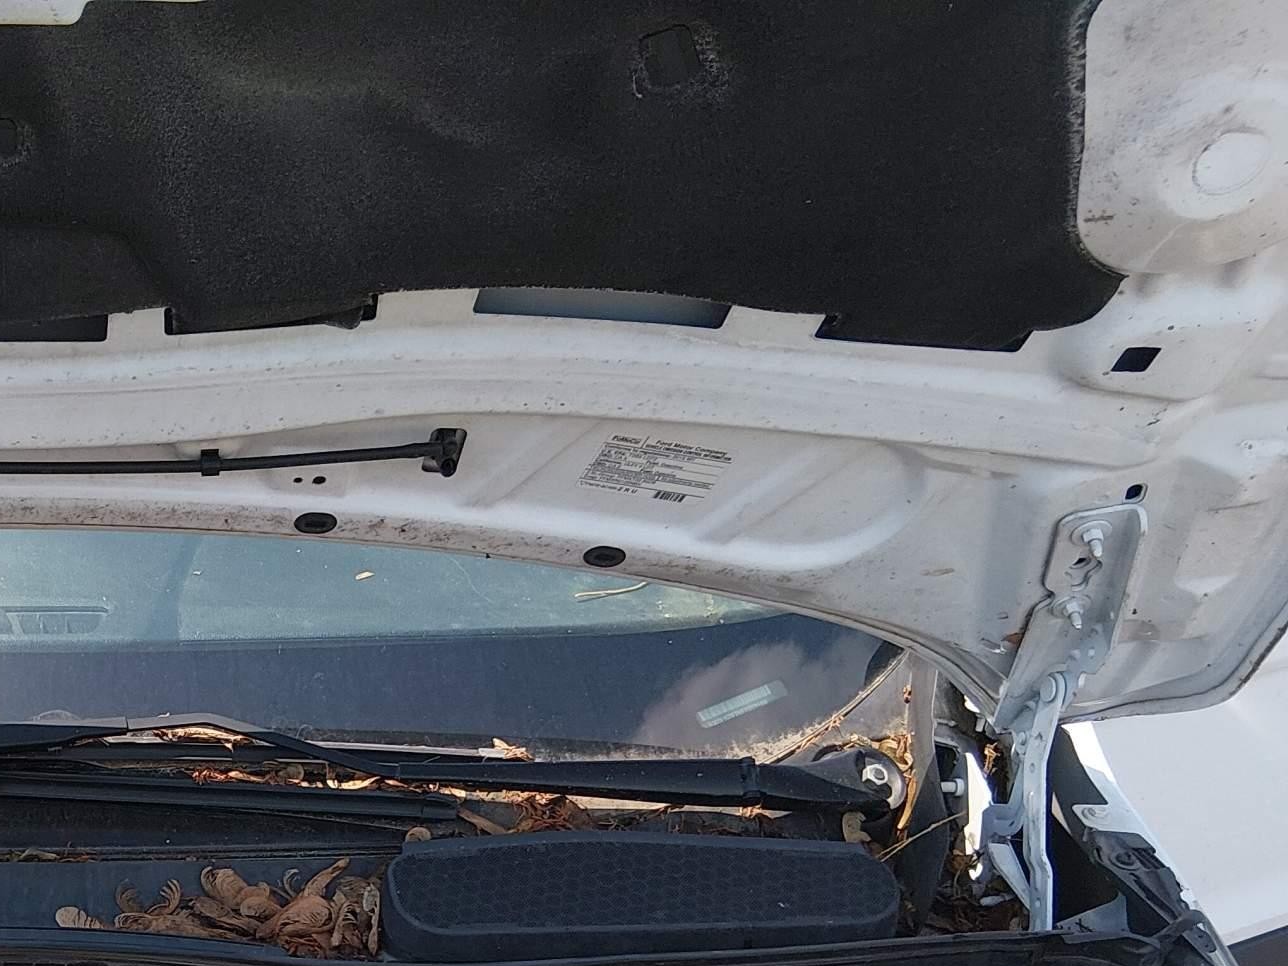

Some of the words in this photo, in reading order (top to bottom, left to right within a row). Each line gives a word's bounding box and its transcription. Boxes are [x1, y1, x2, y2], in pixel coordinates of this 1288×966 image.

[656, 440, 674, 448] Ford
[674, 442, 694, 450] Motor
[695, 446, 728, 458] Company
